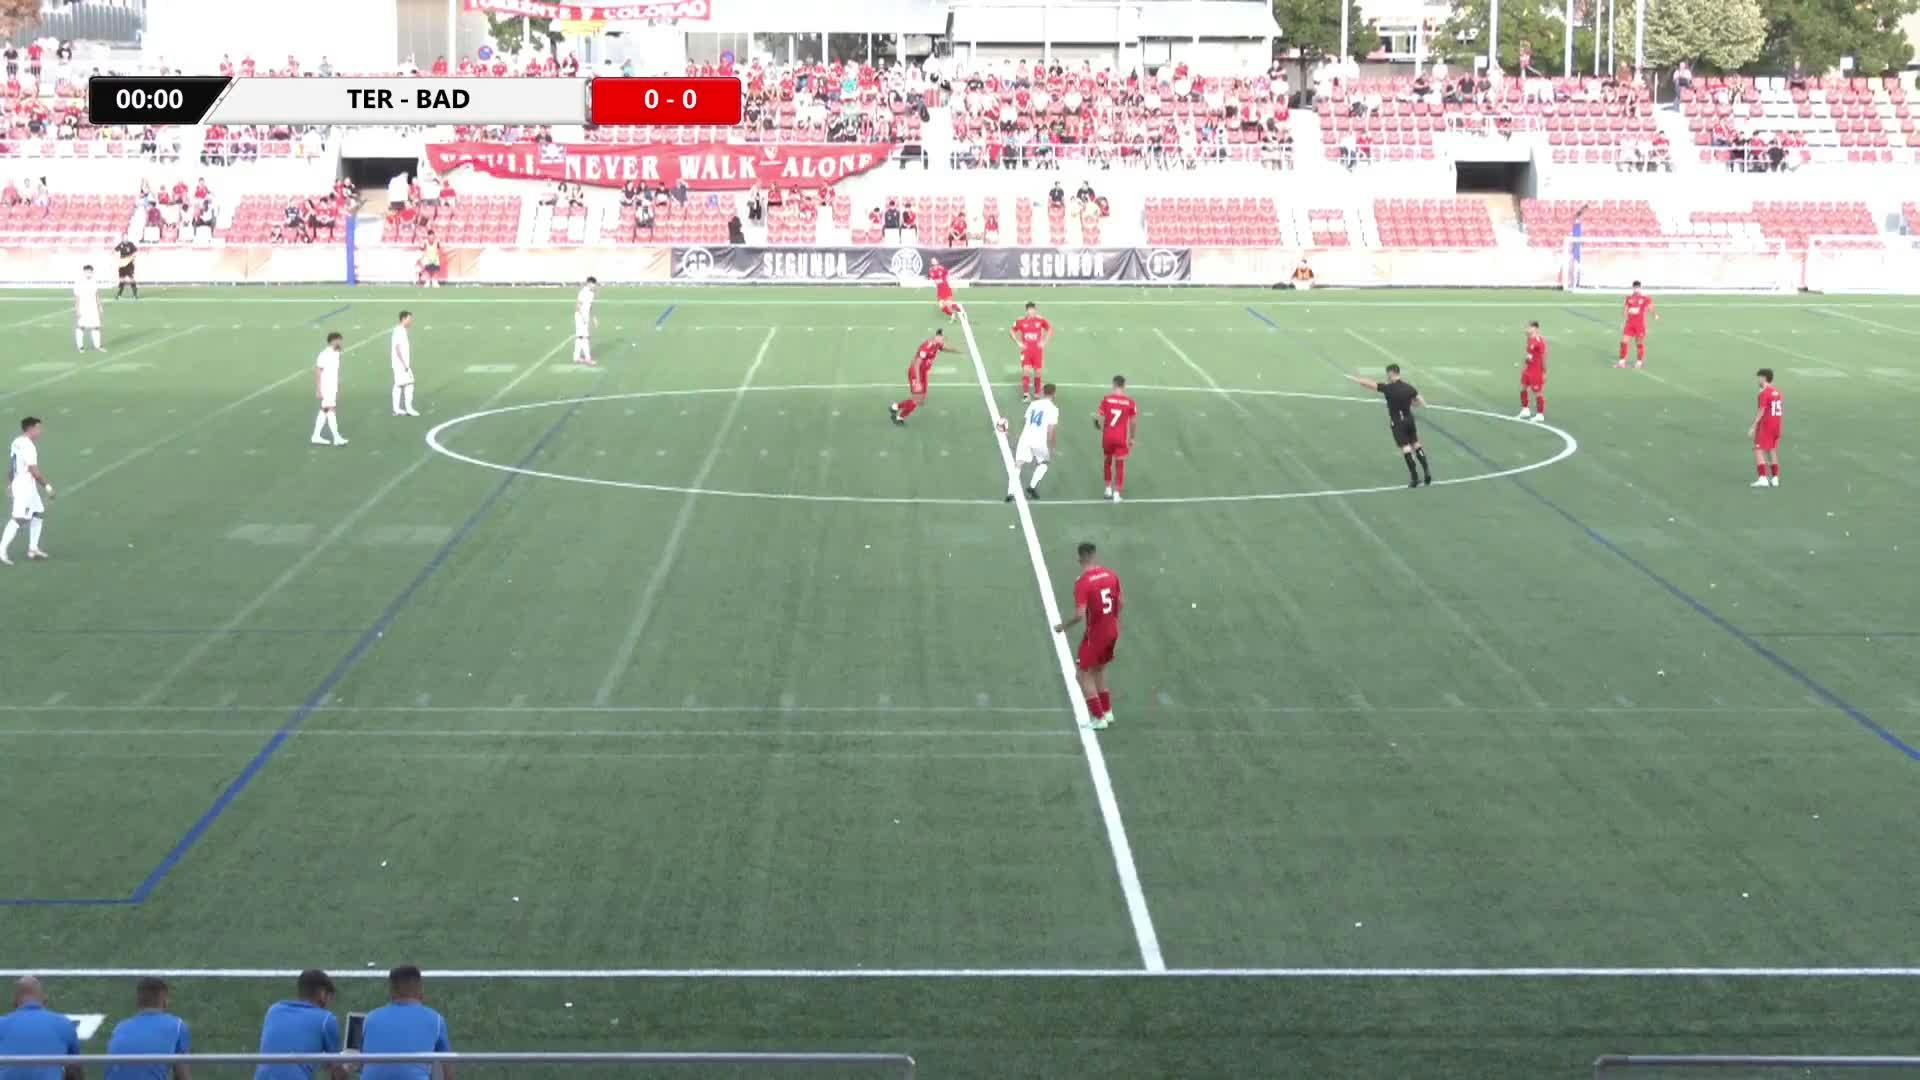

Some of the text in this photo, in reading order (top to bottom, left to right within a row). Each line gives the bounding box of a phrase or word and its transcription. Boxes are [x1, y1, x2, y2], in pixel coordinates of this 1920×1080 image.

[564, 154, 660, 180] NEVER
[679, 154, 757, 180] WALK
[763, 251, 848, 276] SEGUNDA
[1030, 408, 1045, 427] 14
[1109, 407, 1123, 428] 7
[1771, 399, 1783, 417] 15
[1100, 587, 1113, 615] 5
